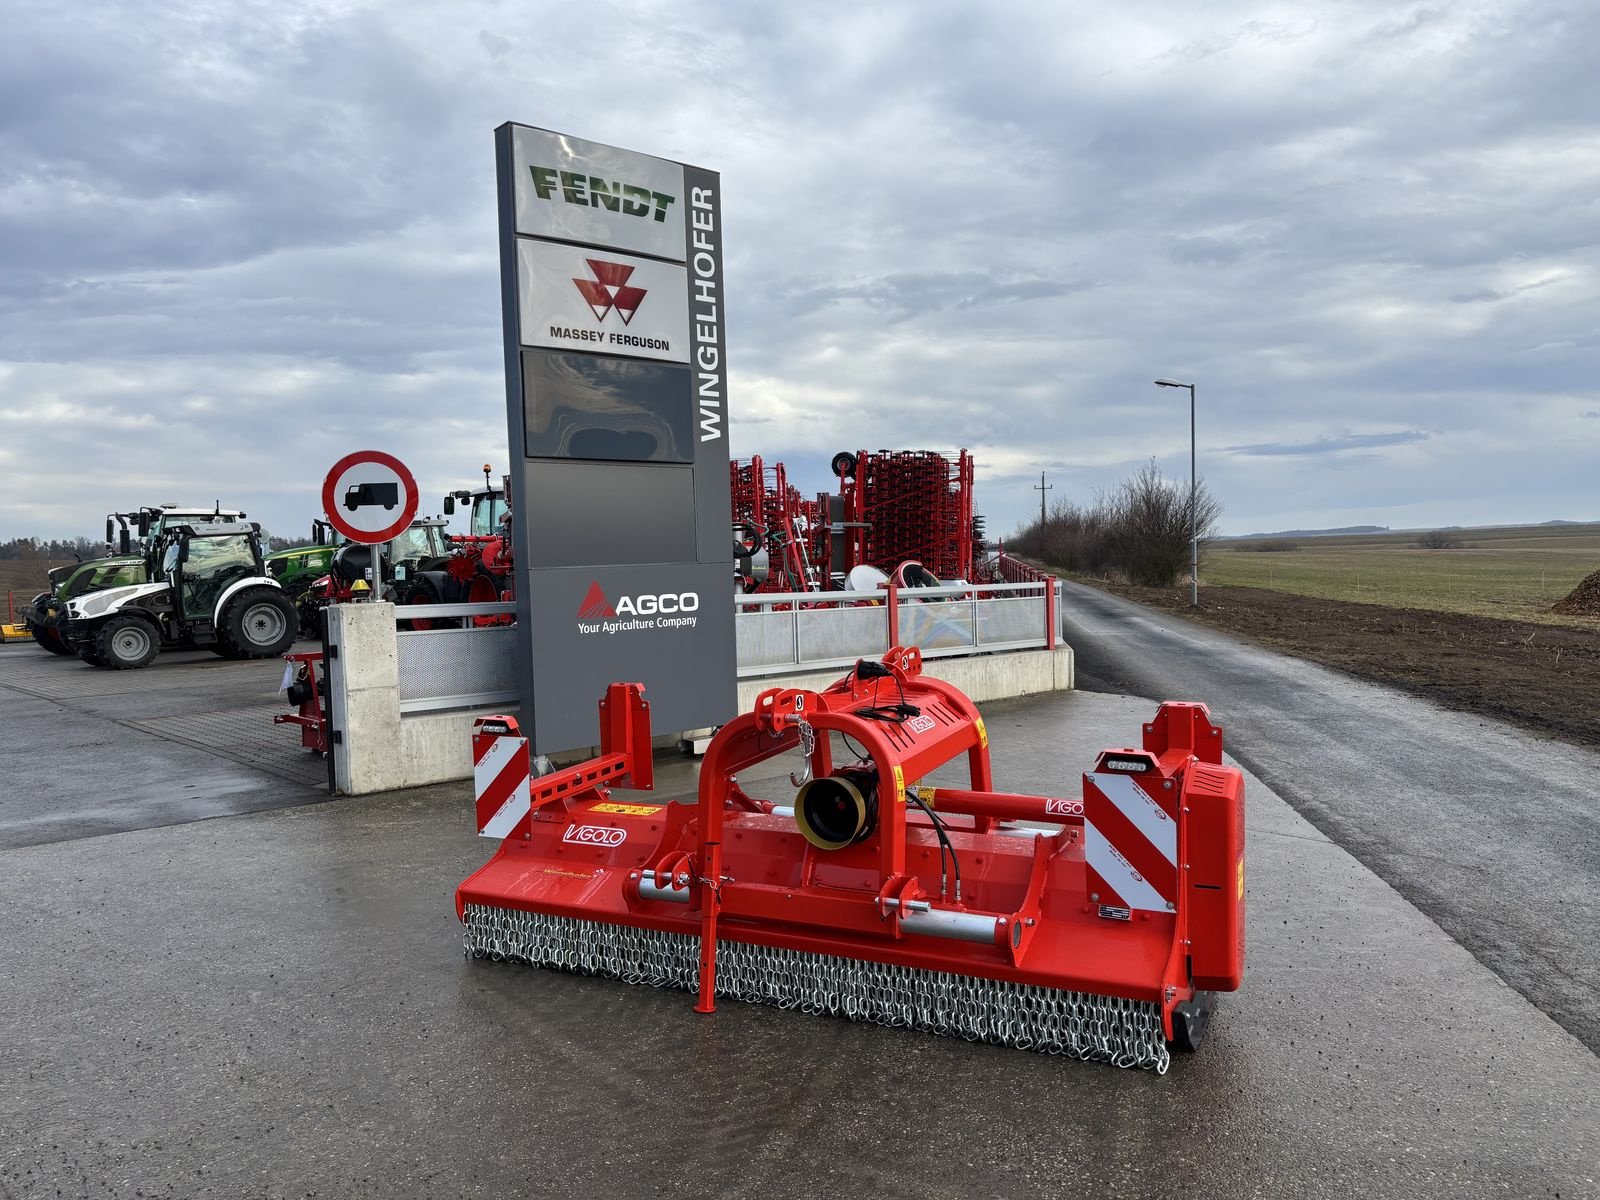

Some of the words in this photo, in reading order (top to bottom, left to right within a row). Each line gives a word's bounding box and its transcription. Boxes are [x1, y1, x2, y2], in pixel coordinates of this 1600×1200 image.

[529, 165, 675, 223] FENDT
[691, 186, 721, 442] WINGELHOFER
[550, 326, 605, 342] MASSEY
[609, 333, 670, 351] FERGUSON
[615, 592, 699, 616] AGCO
[578, 623, 600, 634] Your
[602, 618, 654, 635] Agriculture
[656, 616, 697, 629] Company
[1046, 799, 1084, 815] VIGO
